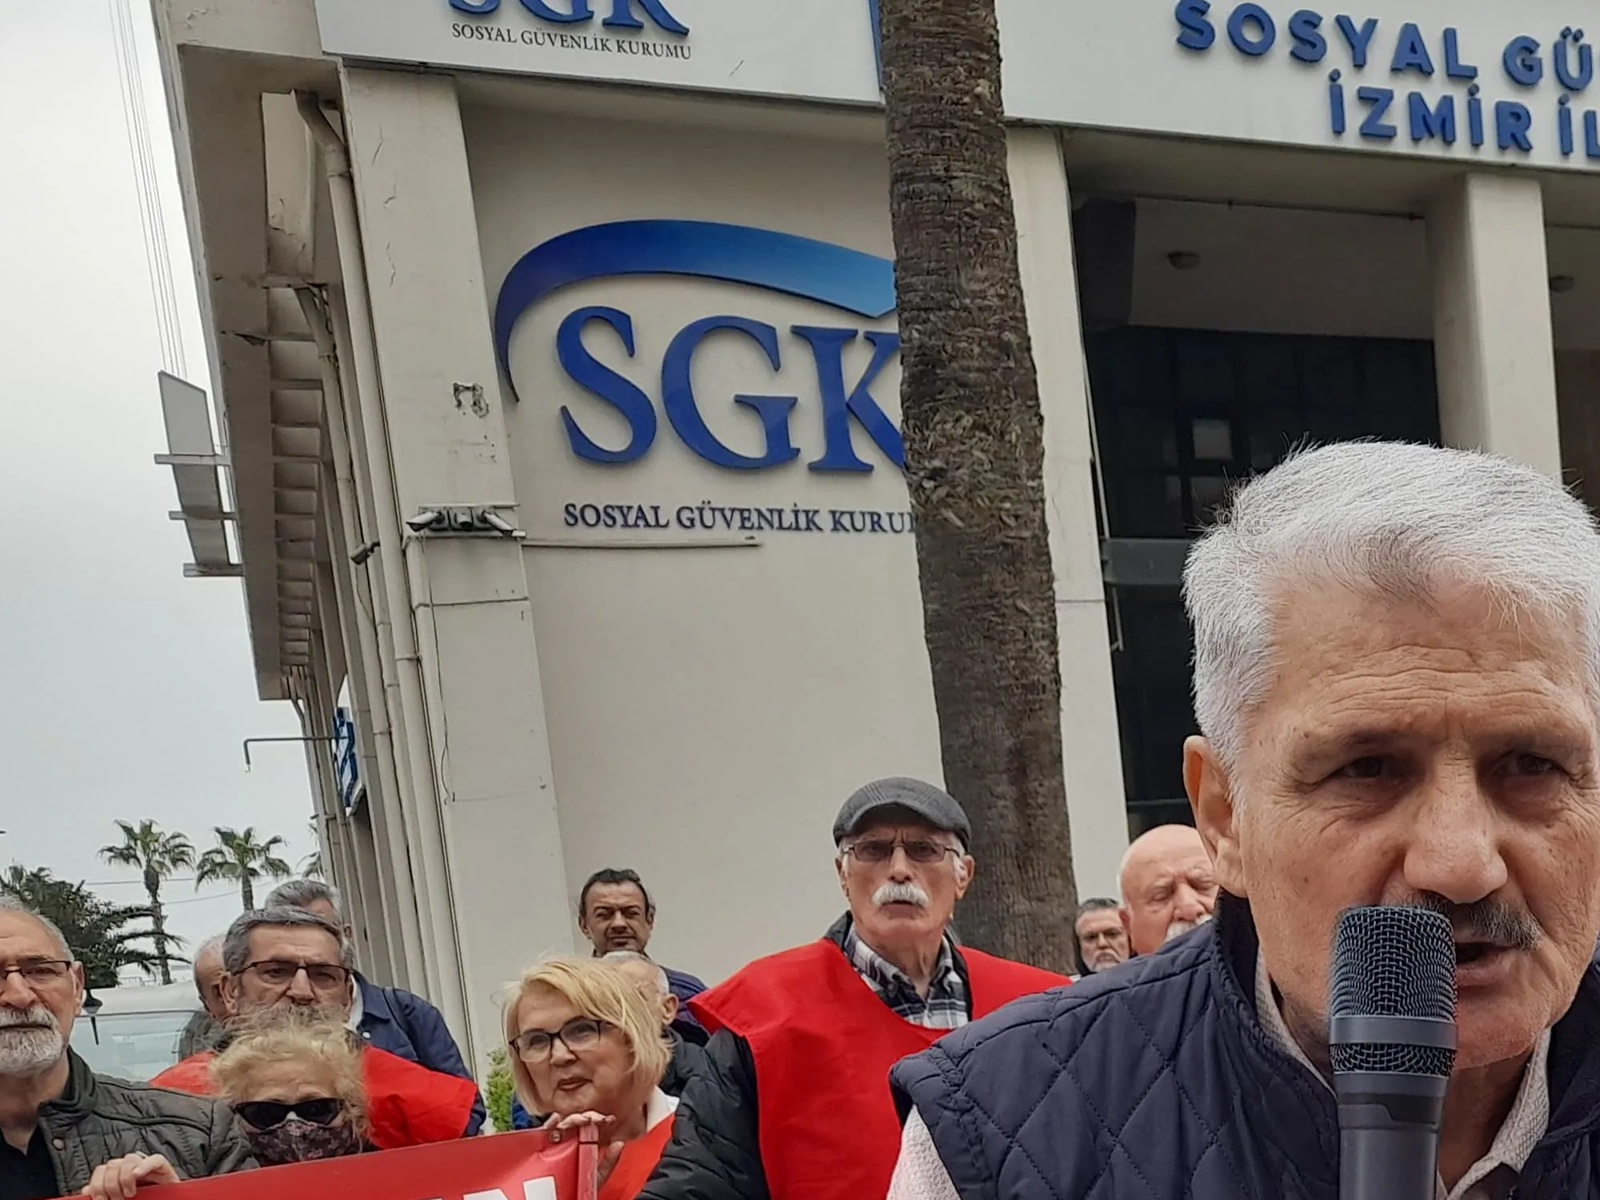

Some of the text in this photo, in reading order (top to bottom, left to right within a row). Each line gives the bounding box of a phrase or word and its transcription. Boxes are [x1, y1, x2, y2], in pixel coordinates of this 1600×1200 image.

[451, 22, 692, 60] SOSYAL GÜVENLİK KURUMU
[1174, 0, 1478, 81] SOSYAL
[1328, 69, 1533, 153] İZMİR
[556, 305, 908, 473] SGK
[564, 502, 669, 528] SOSYAL
[676, 500, 824, 533] GÜVENLİK
